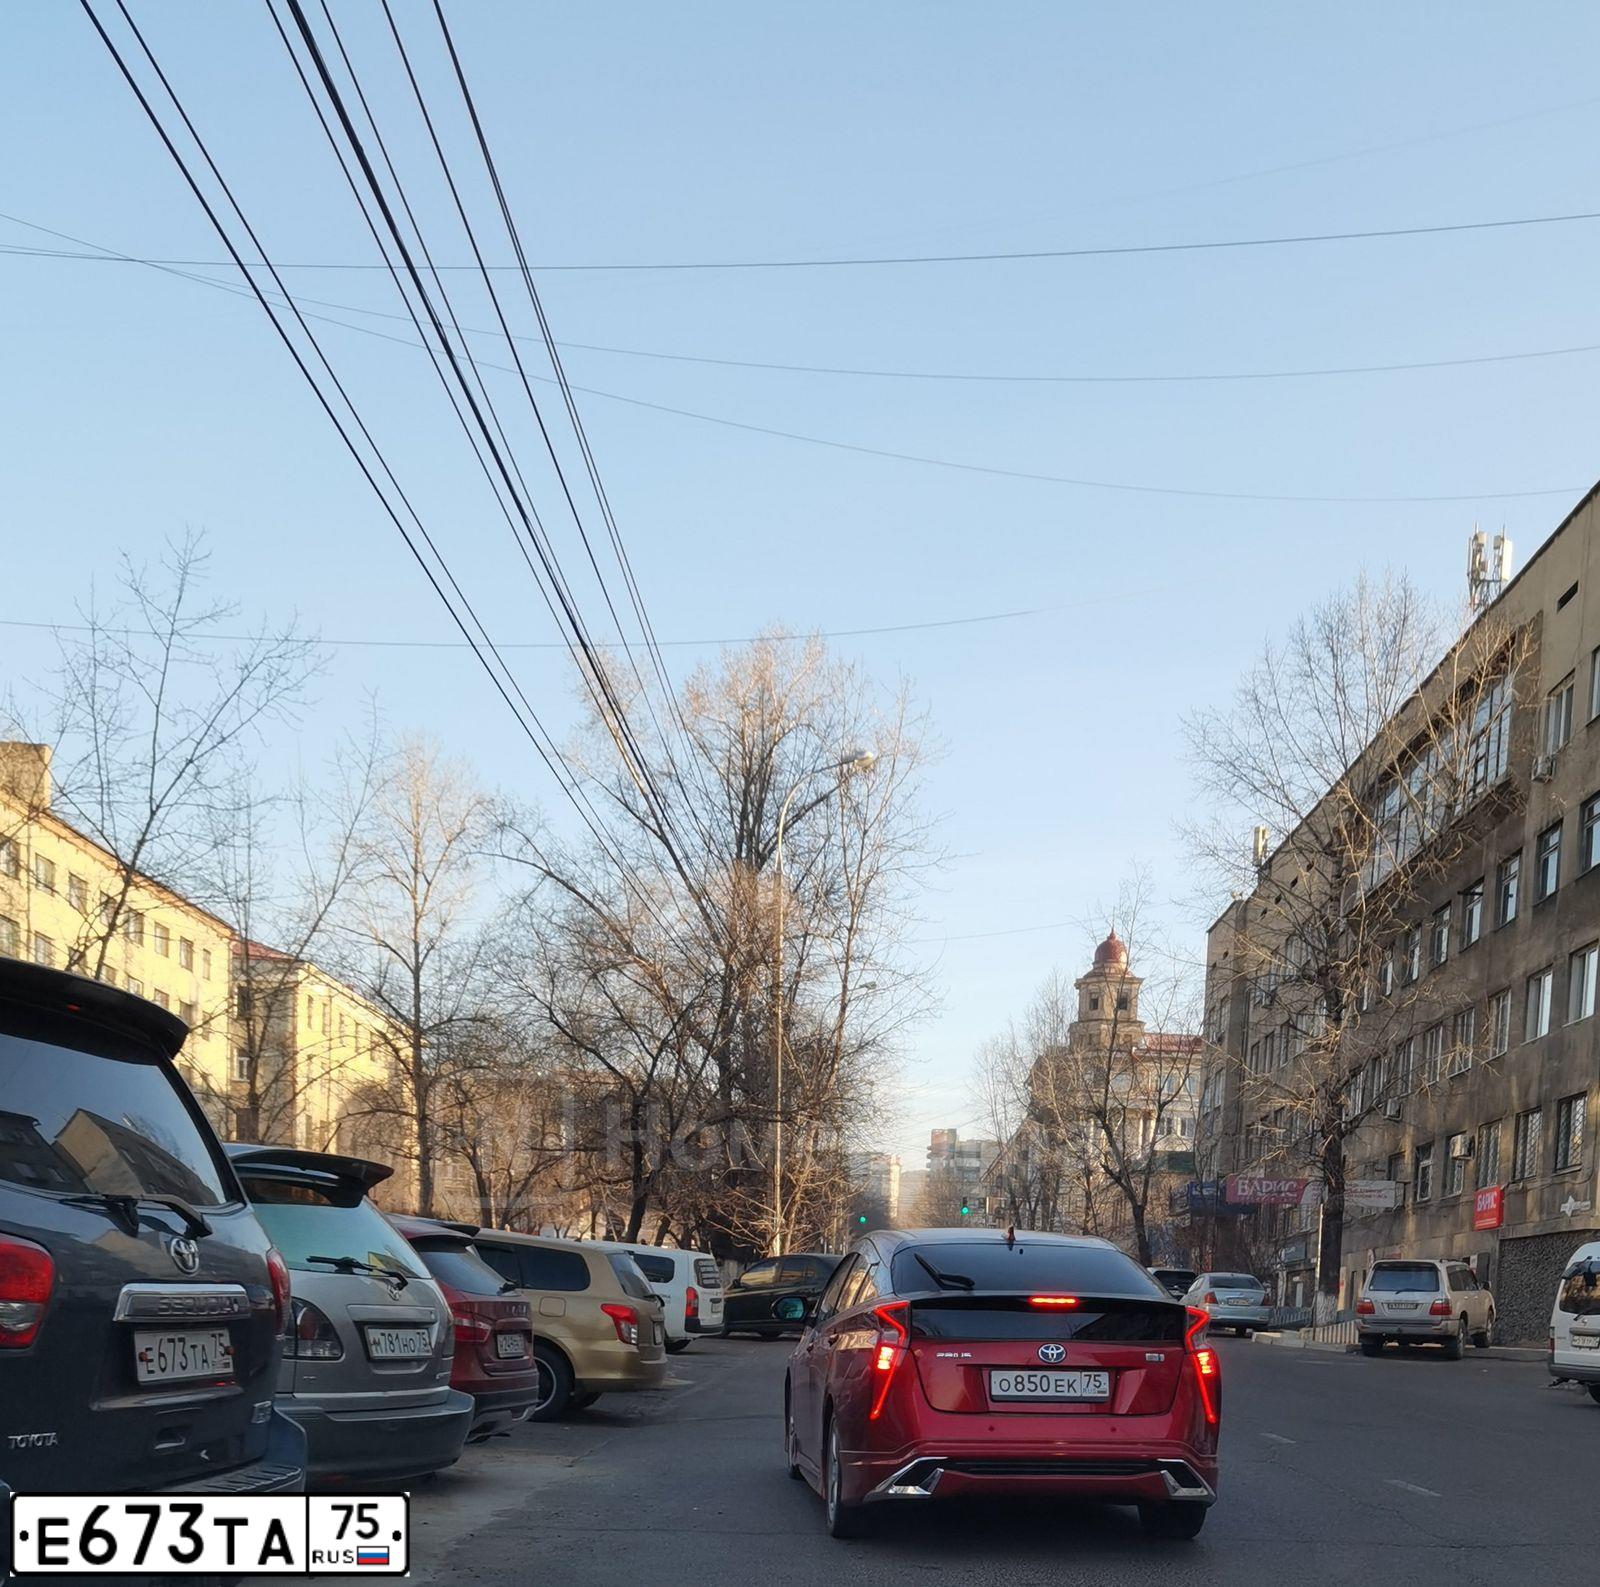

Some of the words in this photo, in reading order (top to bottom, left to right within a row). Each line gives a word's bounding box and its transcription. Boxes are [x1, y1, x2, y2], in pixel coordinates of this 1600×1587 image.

[144, 1337, 209, 1375] Е673ТА
[211, 1332, 227, 1359] 75
[999, 1374, 1077, 1393] О850ЕК
[1083, 1373, 1102, 1389] 75
[8, 1432, 58, 1448] TOYOTA
